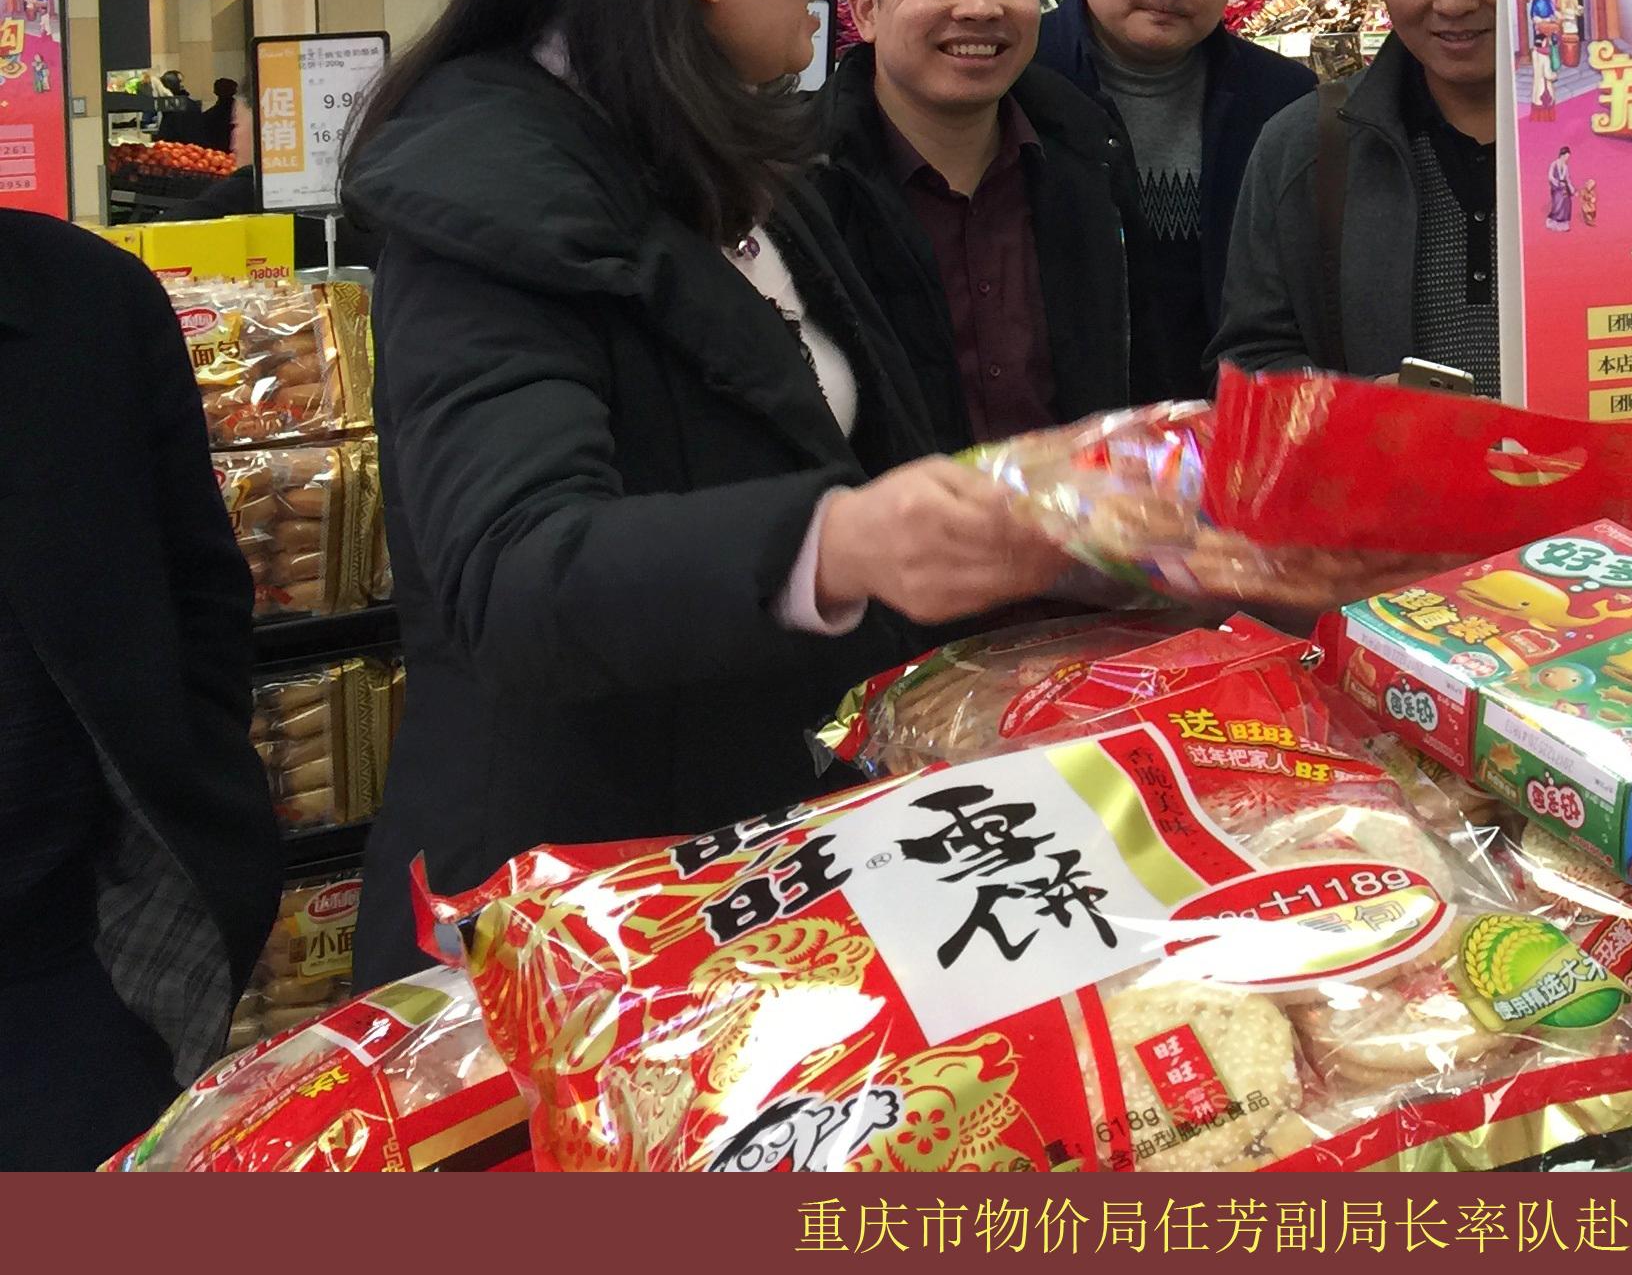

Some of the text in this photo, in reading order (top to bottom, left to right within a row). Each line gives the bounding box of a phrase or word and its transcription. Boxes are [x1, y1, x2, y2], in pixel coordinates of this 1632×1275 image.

[261, 87, 297, 152] 促销
[263, 156, 298, 169] SALE
[896, 783, 1118, 969] 雪饼
[1096, 1108, 1160, 1143] 618g
